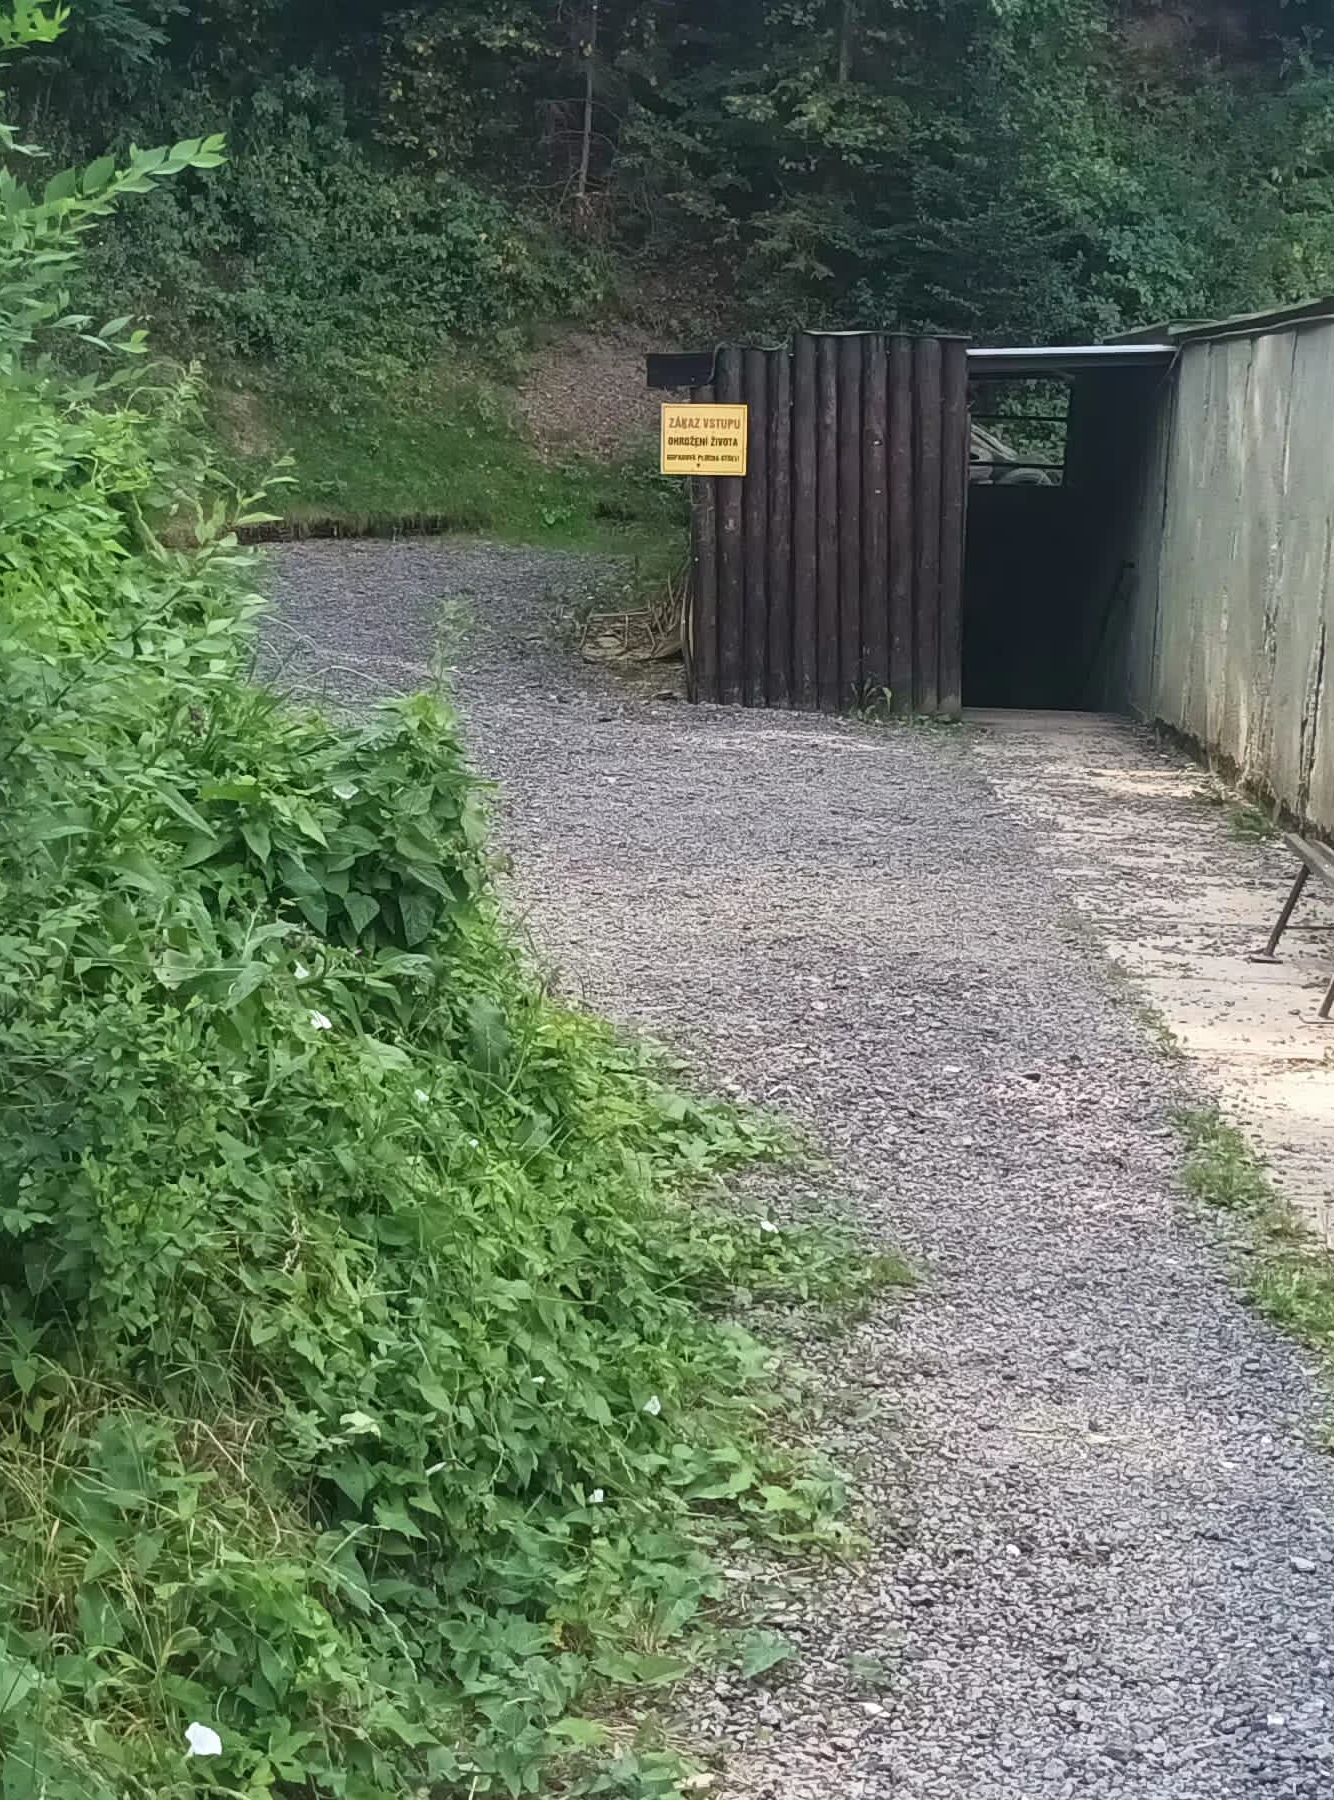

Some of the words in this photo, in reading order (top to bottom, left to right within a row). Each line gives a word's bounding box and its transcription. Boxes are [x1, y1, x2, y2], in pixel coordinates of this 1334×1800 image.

[669, 416, 700, 429] ZÁKAZ
[703, 418, 740, 430] VSTUPU
[710, 436, 738, 447] ŽIVOTA
